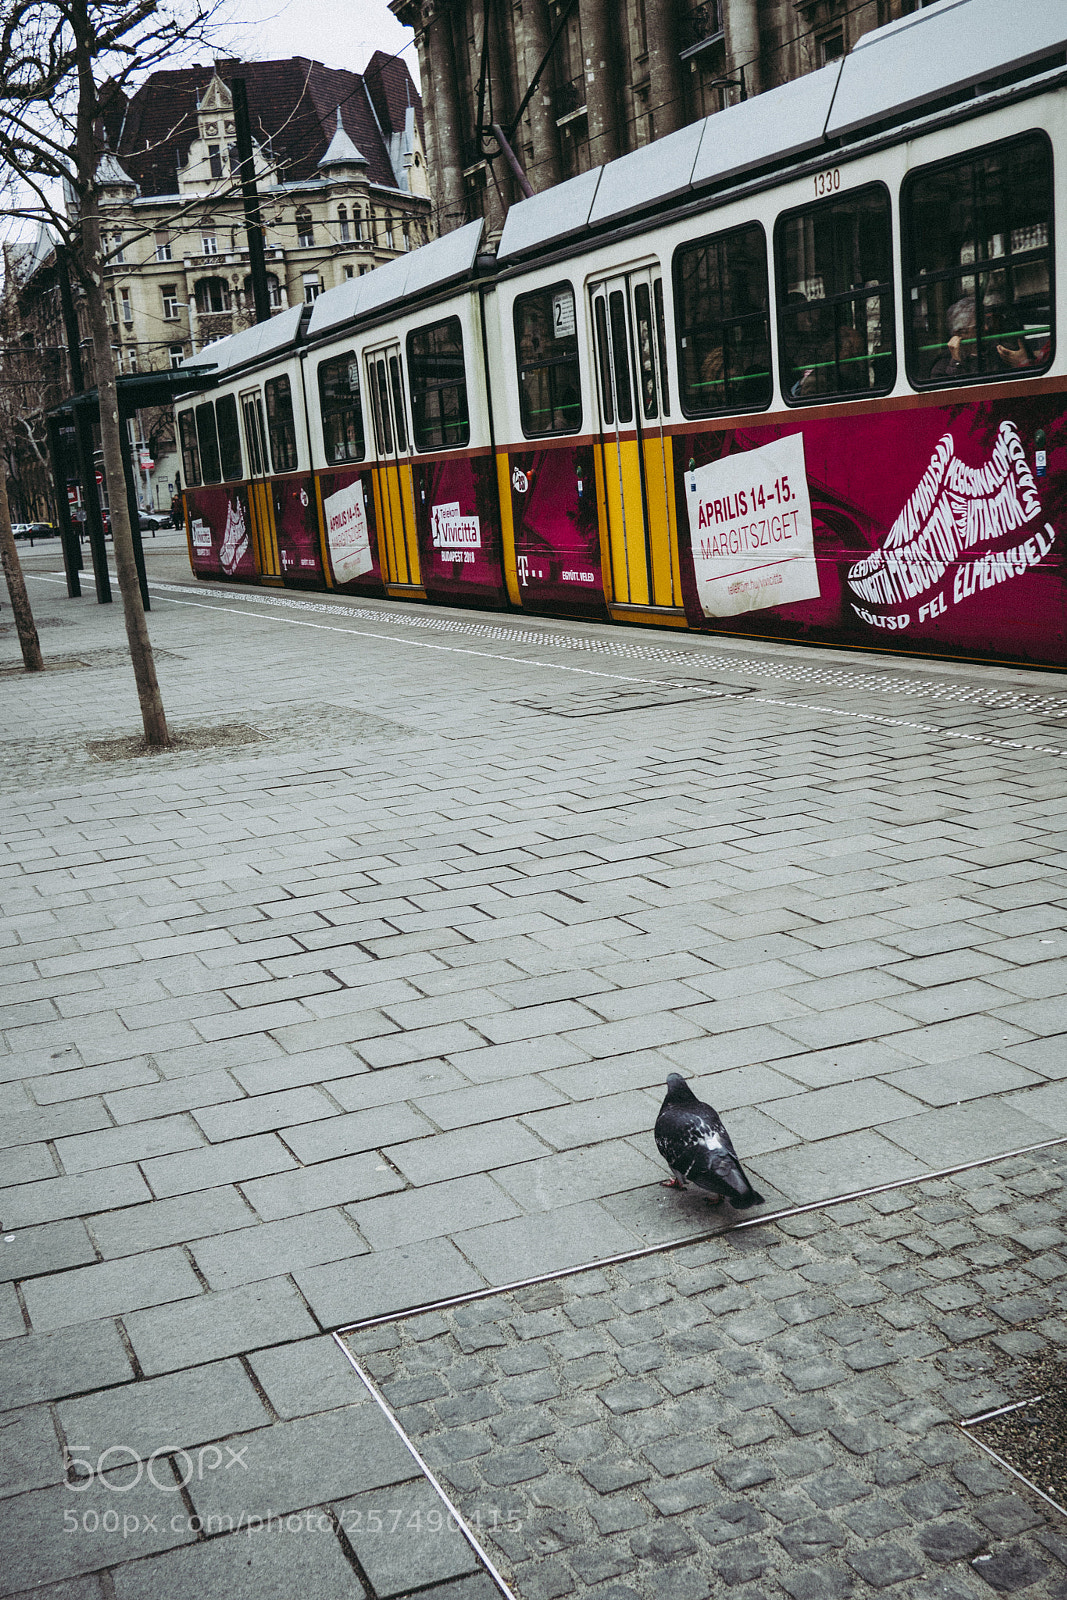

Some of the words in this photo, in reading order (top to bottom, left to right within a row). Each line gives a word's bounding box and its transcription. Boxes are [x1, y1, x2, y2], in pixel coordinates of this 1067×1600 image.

[814, 169, 840, 197] 1330
[555, 303, 563, 327] 2
[944, 433, 1012, 498] MEGCSINÁLOM
[698, 490, 748, 530] ÁPRILIS
[750, 476, 796, 512] 14-15.
[965, 472, 1029, 549] KITARTOK
[441, 520, 477, 542] Vivicittá
[441, 550, 464, 562] BUDAPEST
[700, 510, 799, 560] MARGITSZIGET
[850, 602, 910, 630] TÖLTSD
[918, 591, 948, 623] FEL
[953, 522, 1056, 604] ÉLMÉNNYEL!
